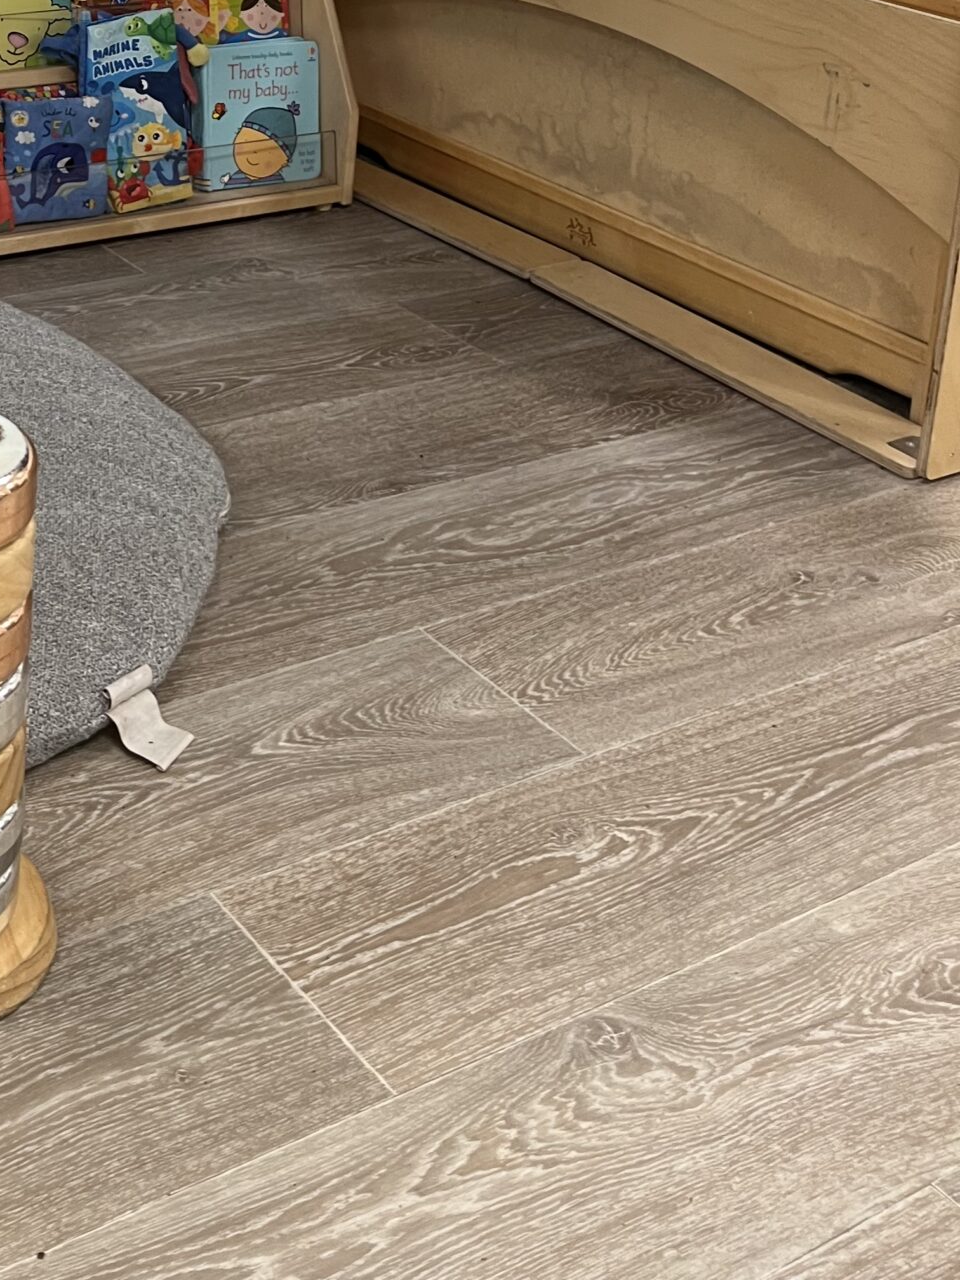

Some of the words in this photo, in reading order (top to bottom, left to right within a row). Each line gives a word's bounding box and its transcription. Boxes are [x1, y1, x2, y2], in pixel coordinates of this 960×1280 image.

[92, 38, 140, 61] MARINE
[93, 54, 154, 79] ANIMALS
[227, 62, 270, 81] That's
[275, 61, 299, 77] not
[228, 87, 251, 104] my
[41, 119, 74, 139] SEA
